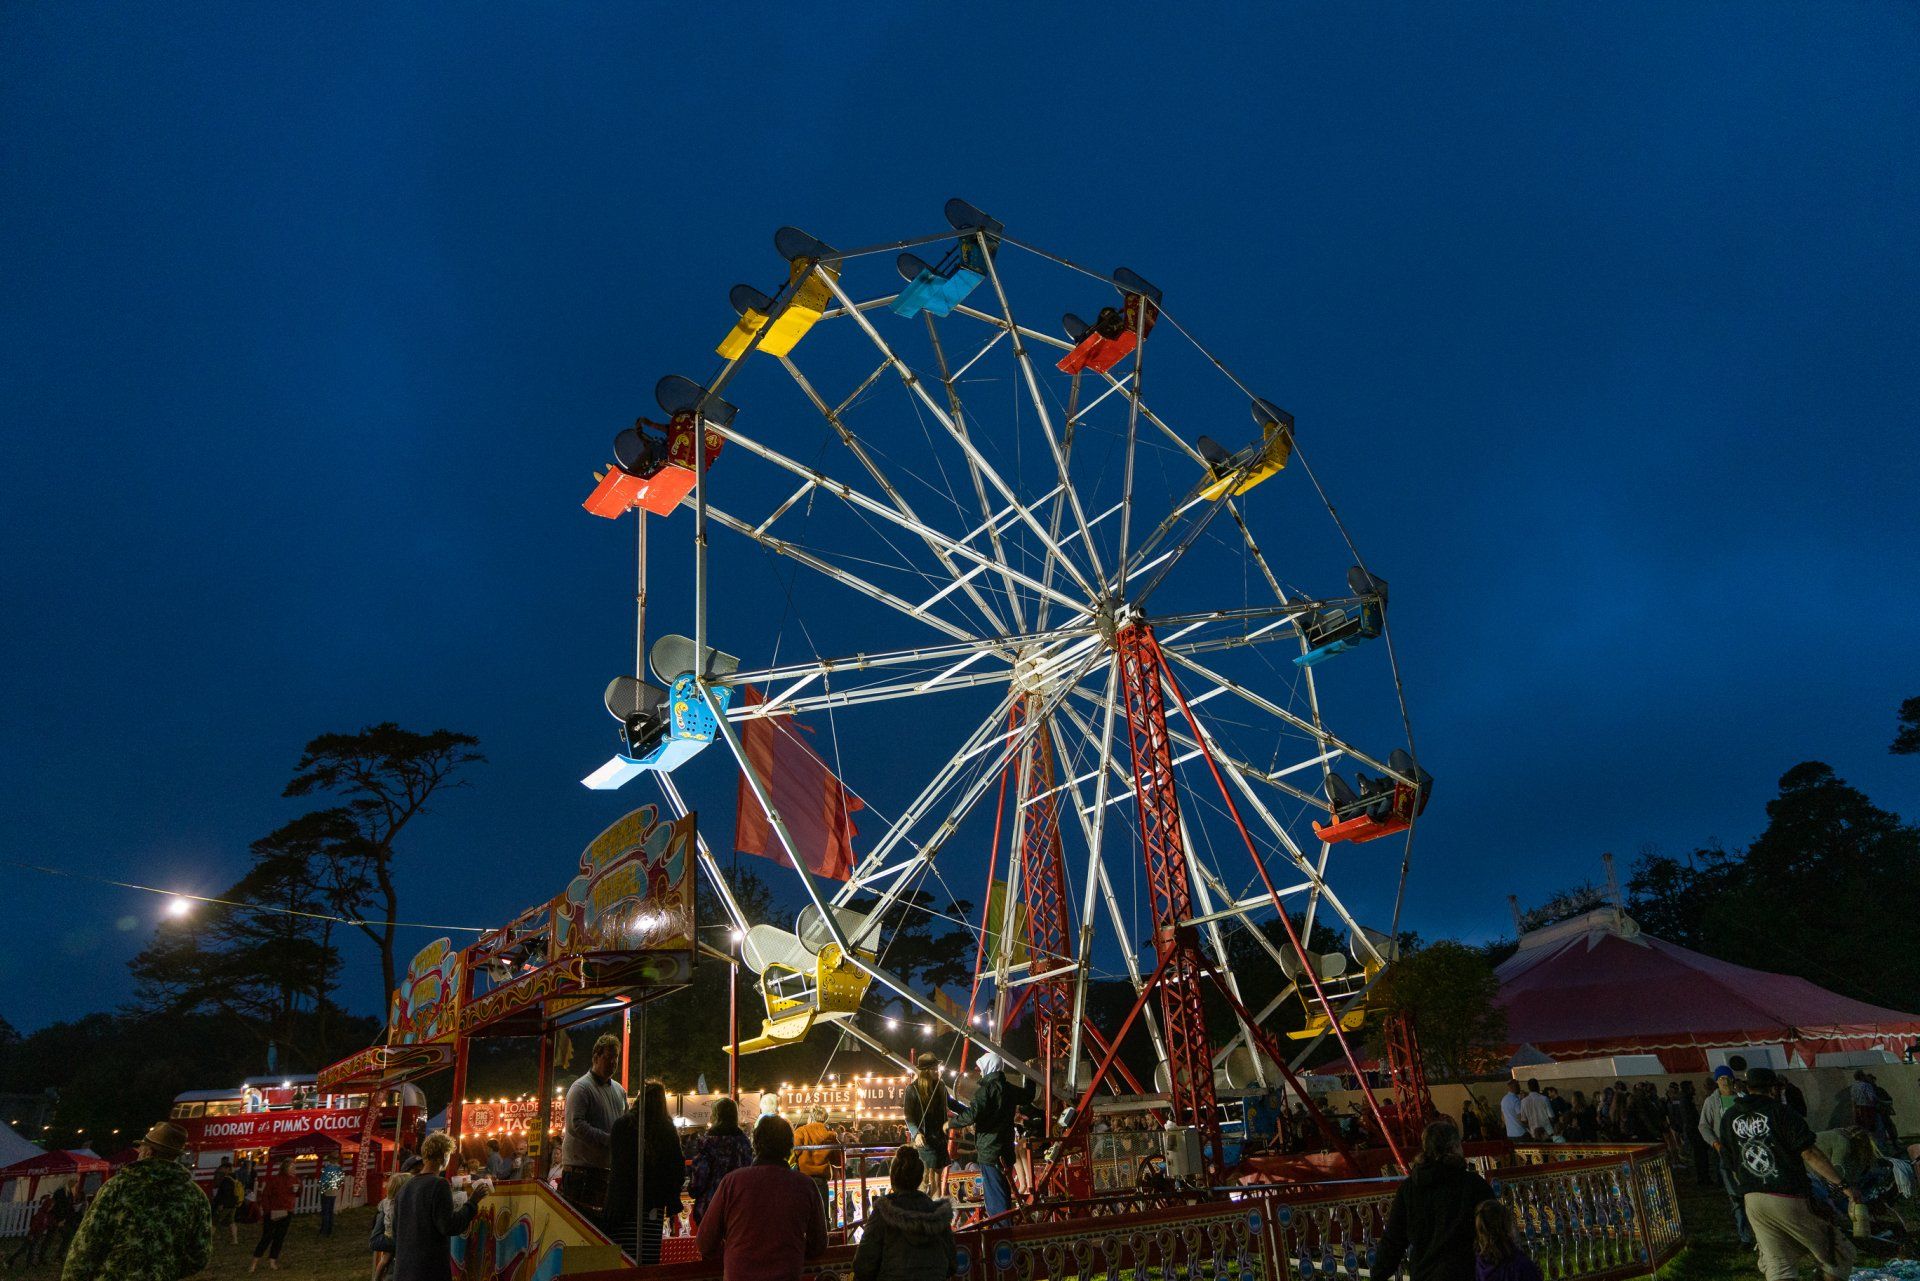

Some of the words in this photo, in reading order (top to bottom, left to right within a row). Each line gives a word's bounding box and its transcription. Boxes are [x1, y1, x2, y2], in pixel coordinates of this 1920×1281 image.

[787, 1090, 850, 1104] TOASTIES
[858, 1089, 884, 1099] WILD
[504, 1102, 539, 1113] LOADE
[204, 1121, 254, 1137] HOORAY!
[257, 1121, 270, 1134] it's
[273, 1117, 310, 1133] PIMM'S
[314, 1115, 361, 1131] O'CLOCK
